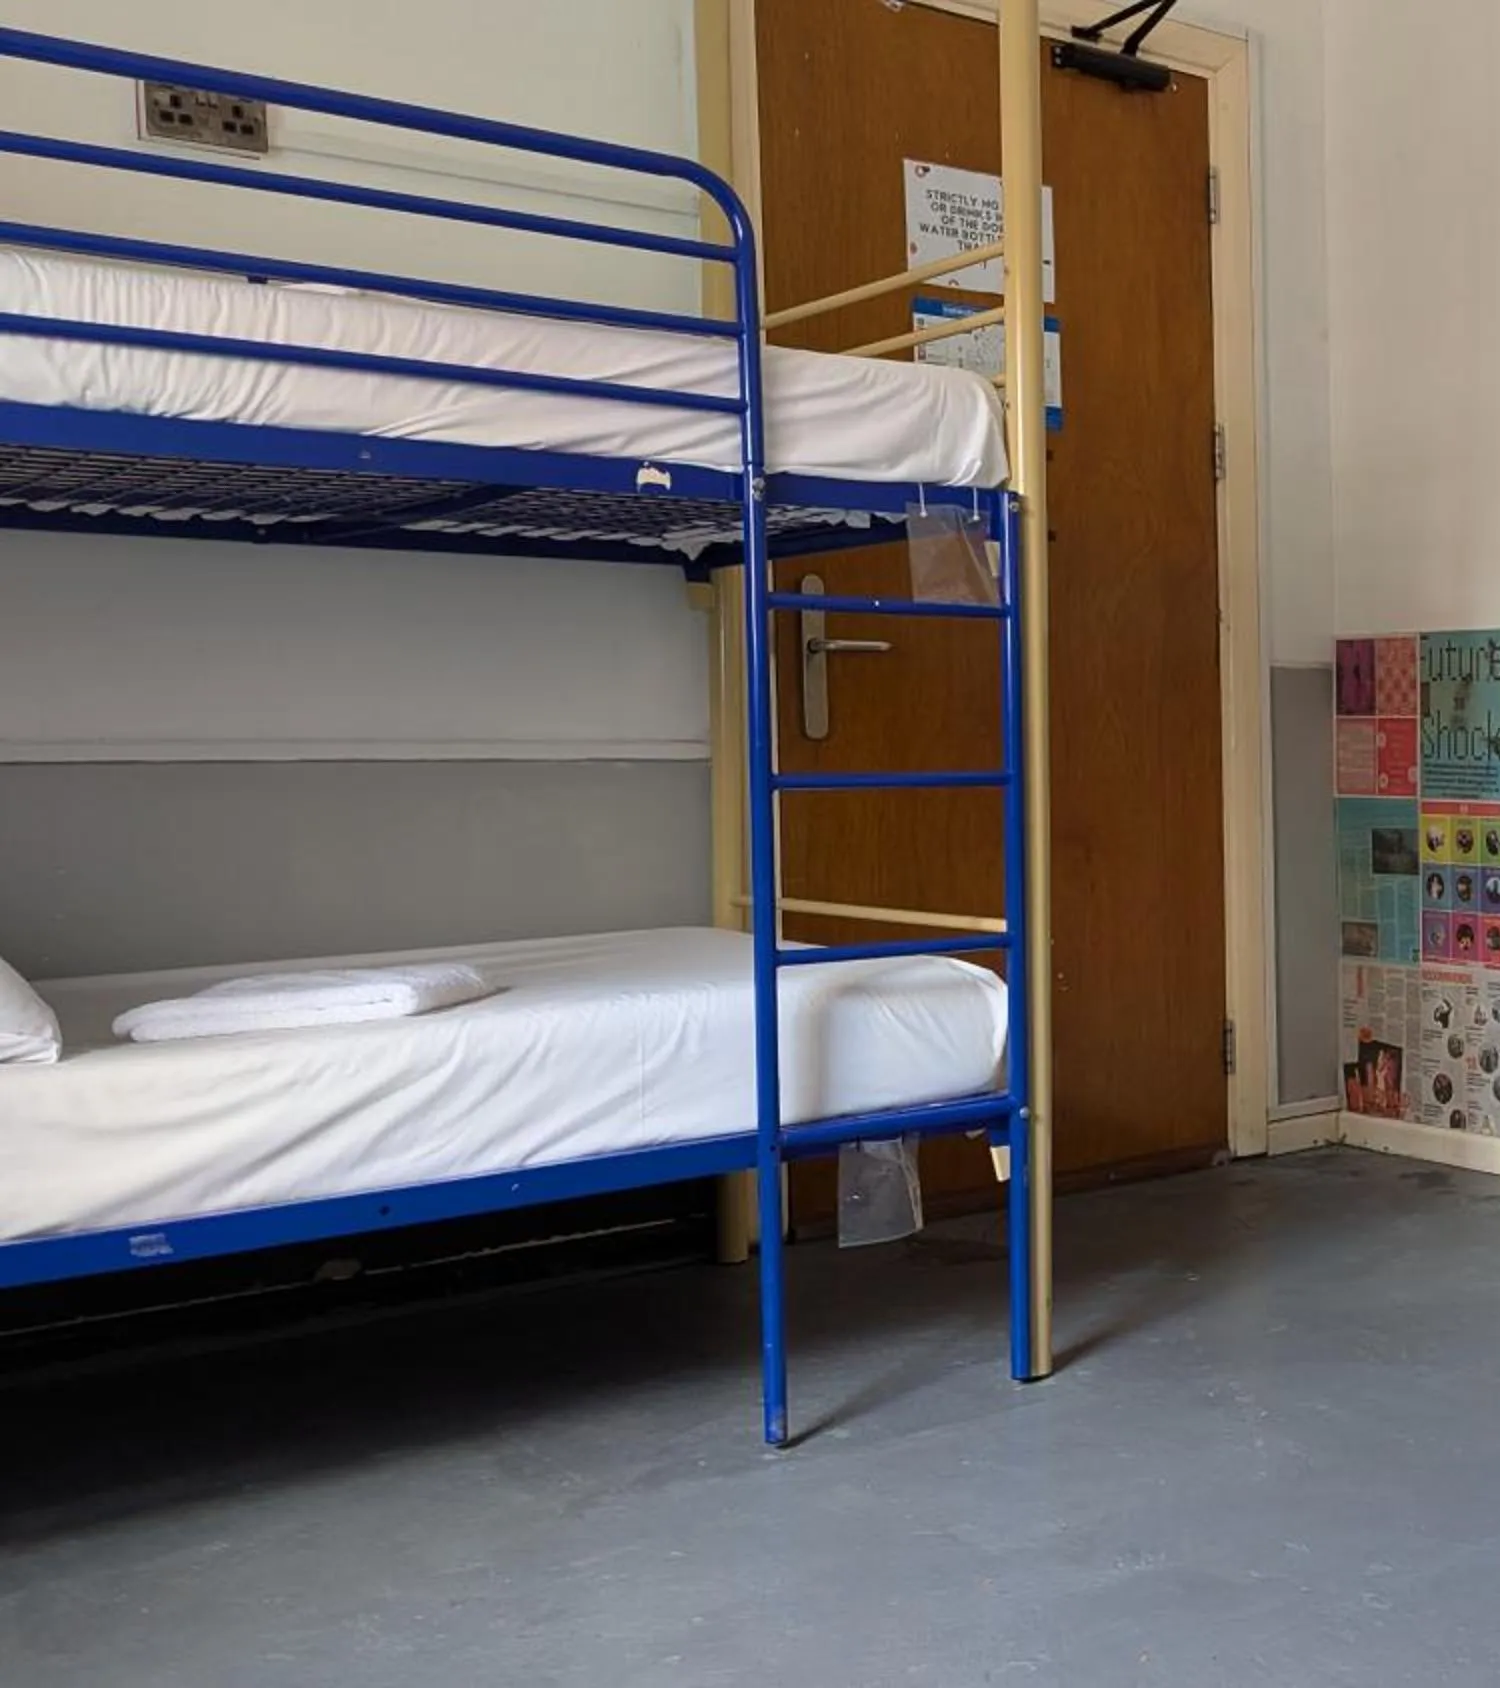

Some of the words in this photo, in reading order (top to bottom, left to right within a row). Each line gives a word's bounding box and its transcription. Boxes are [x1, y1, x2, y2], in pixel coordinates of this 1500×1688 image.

[926, 189, 978, 207] STRICTLY
[931, 201, 947, 213] OR
[919, 222, 959, 238] WATER
[941, 215, 956, 226] OF
[959, 217, 979, 231] THE
